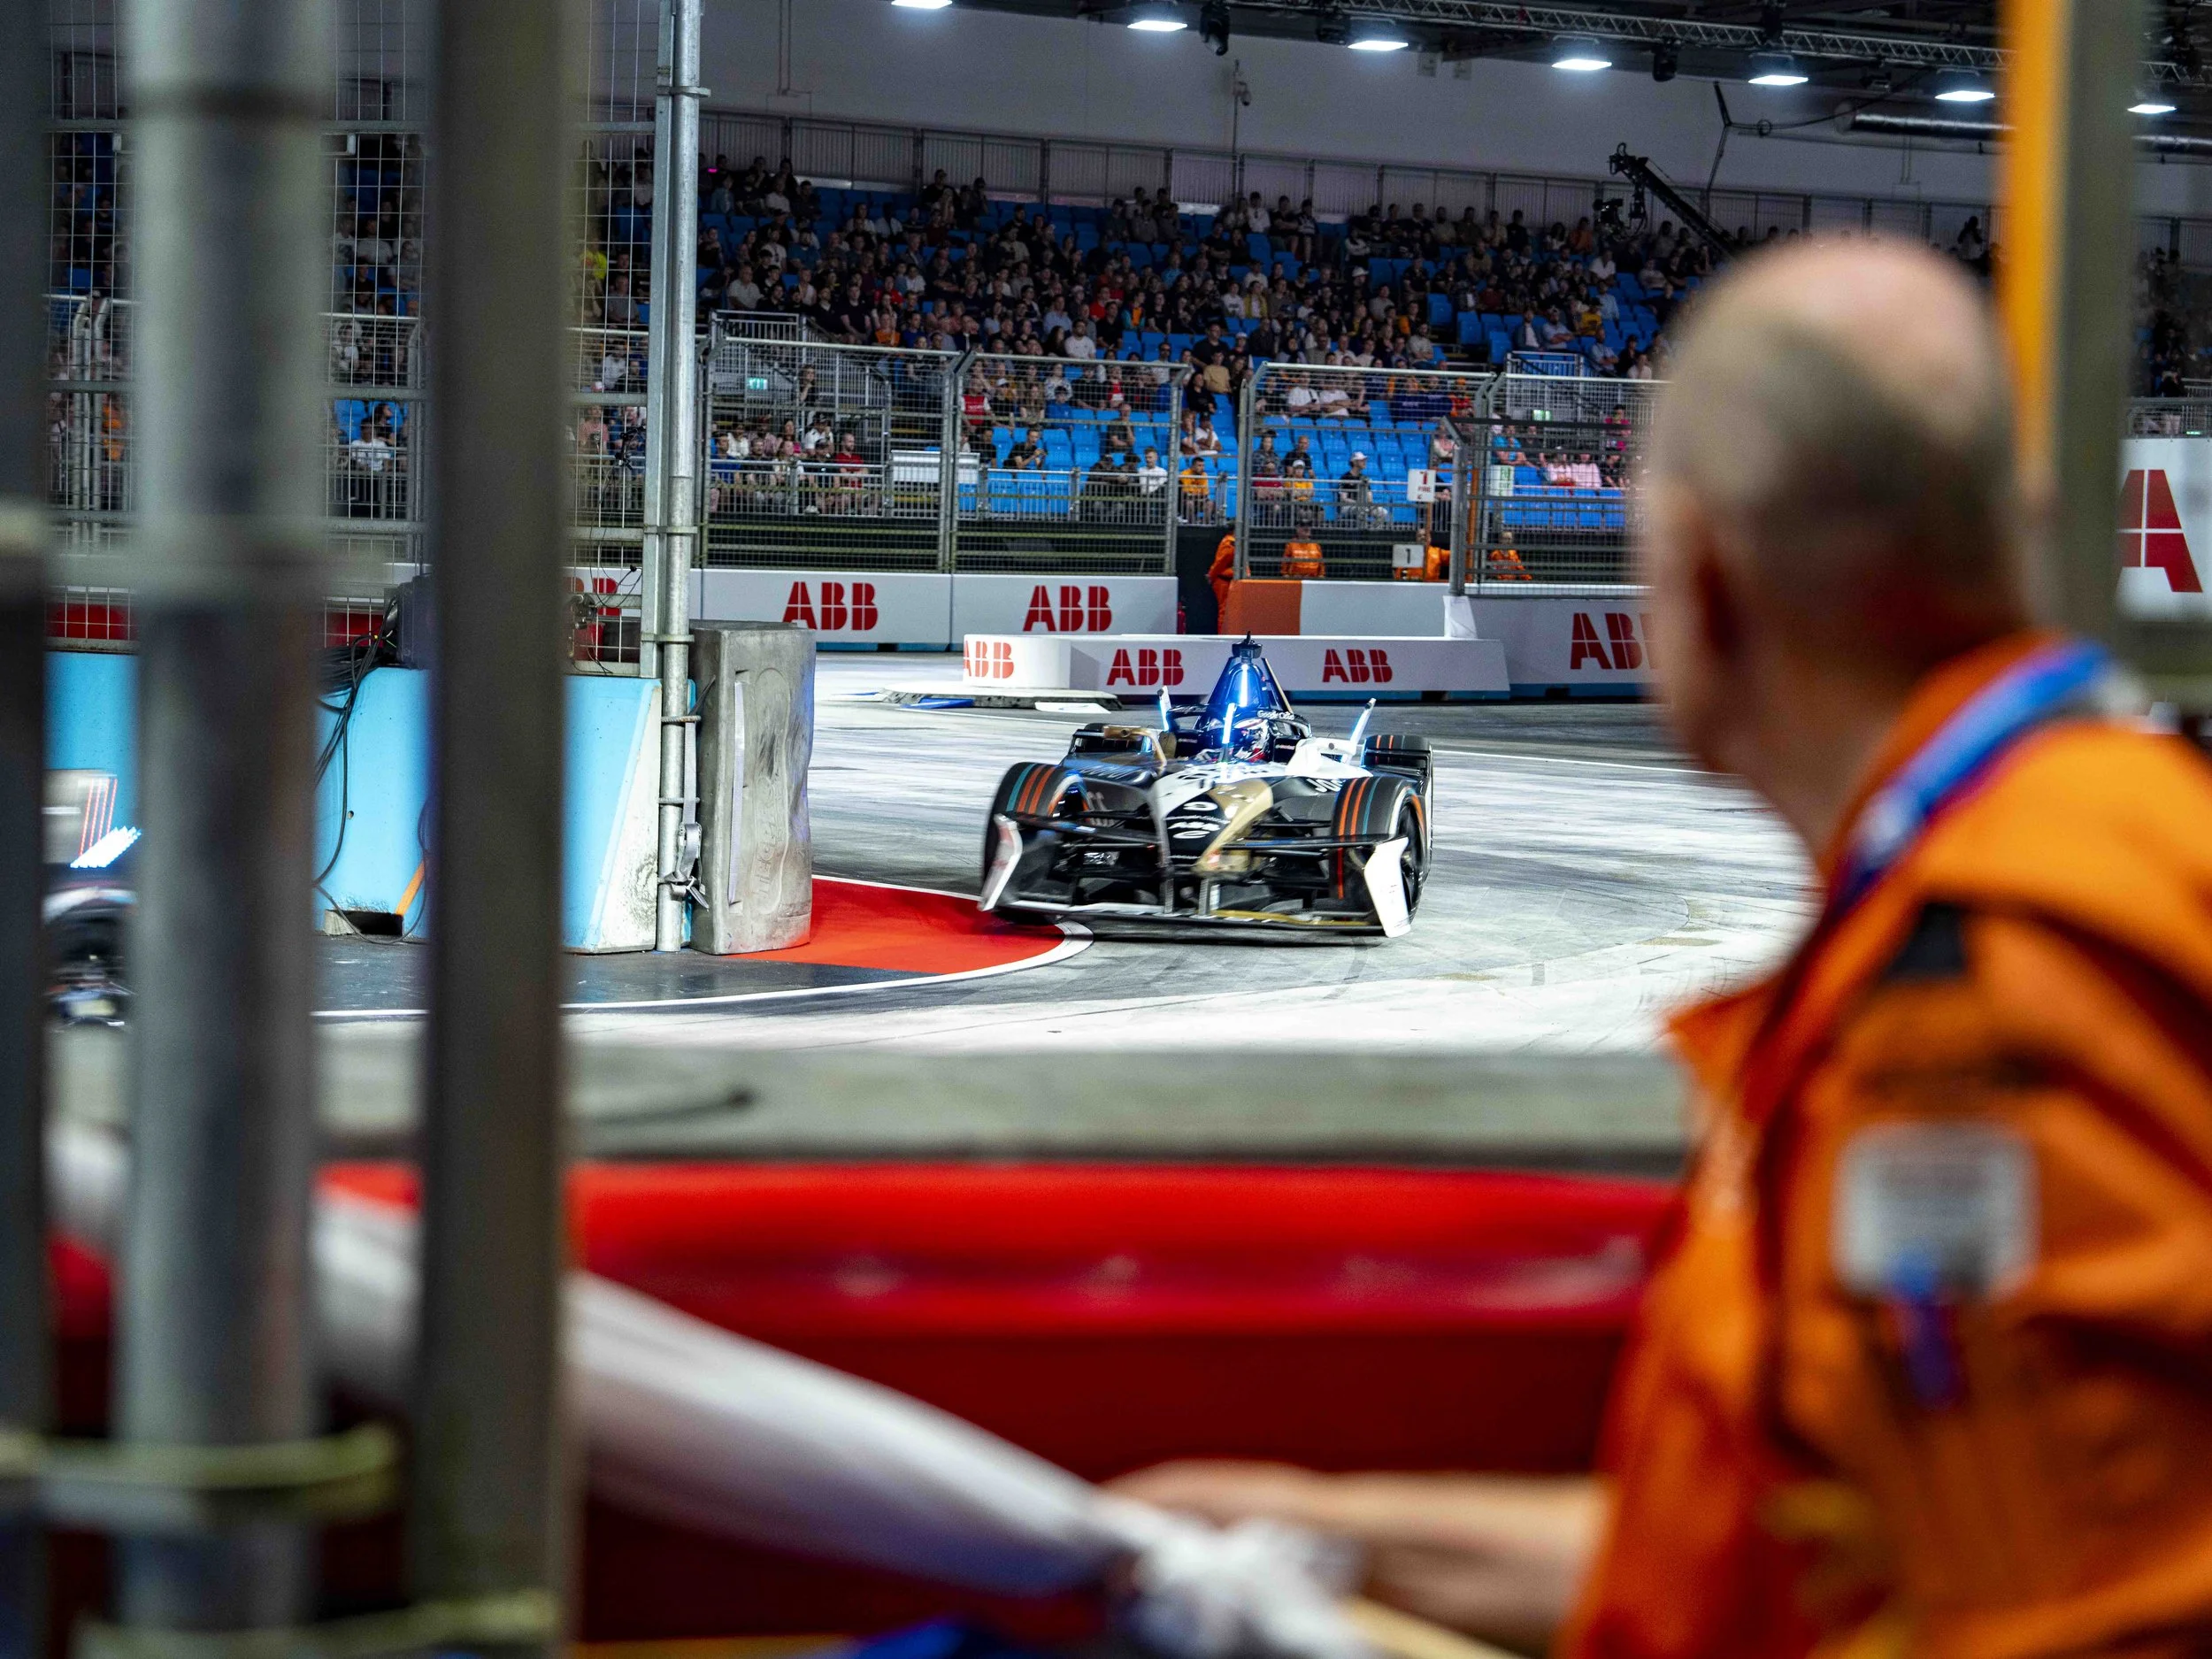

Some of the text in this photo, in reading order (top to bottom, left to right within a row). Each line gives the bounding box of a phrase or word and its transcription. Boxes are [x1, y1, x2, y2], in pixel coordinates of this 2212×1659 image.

[1405, 548, 1411, 564] 1
[783, 581, 878, 631] ABB
[1023, 586, 1112, 632] ABB
[963, 641, 1015, 679] ABB
[1107, 649, 1184, 686] ABB
[1322, 649, 1393, 683] ABB
